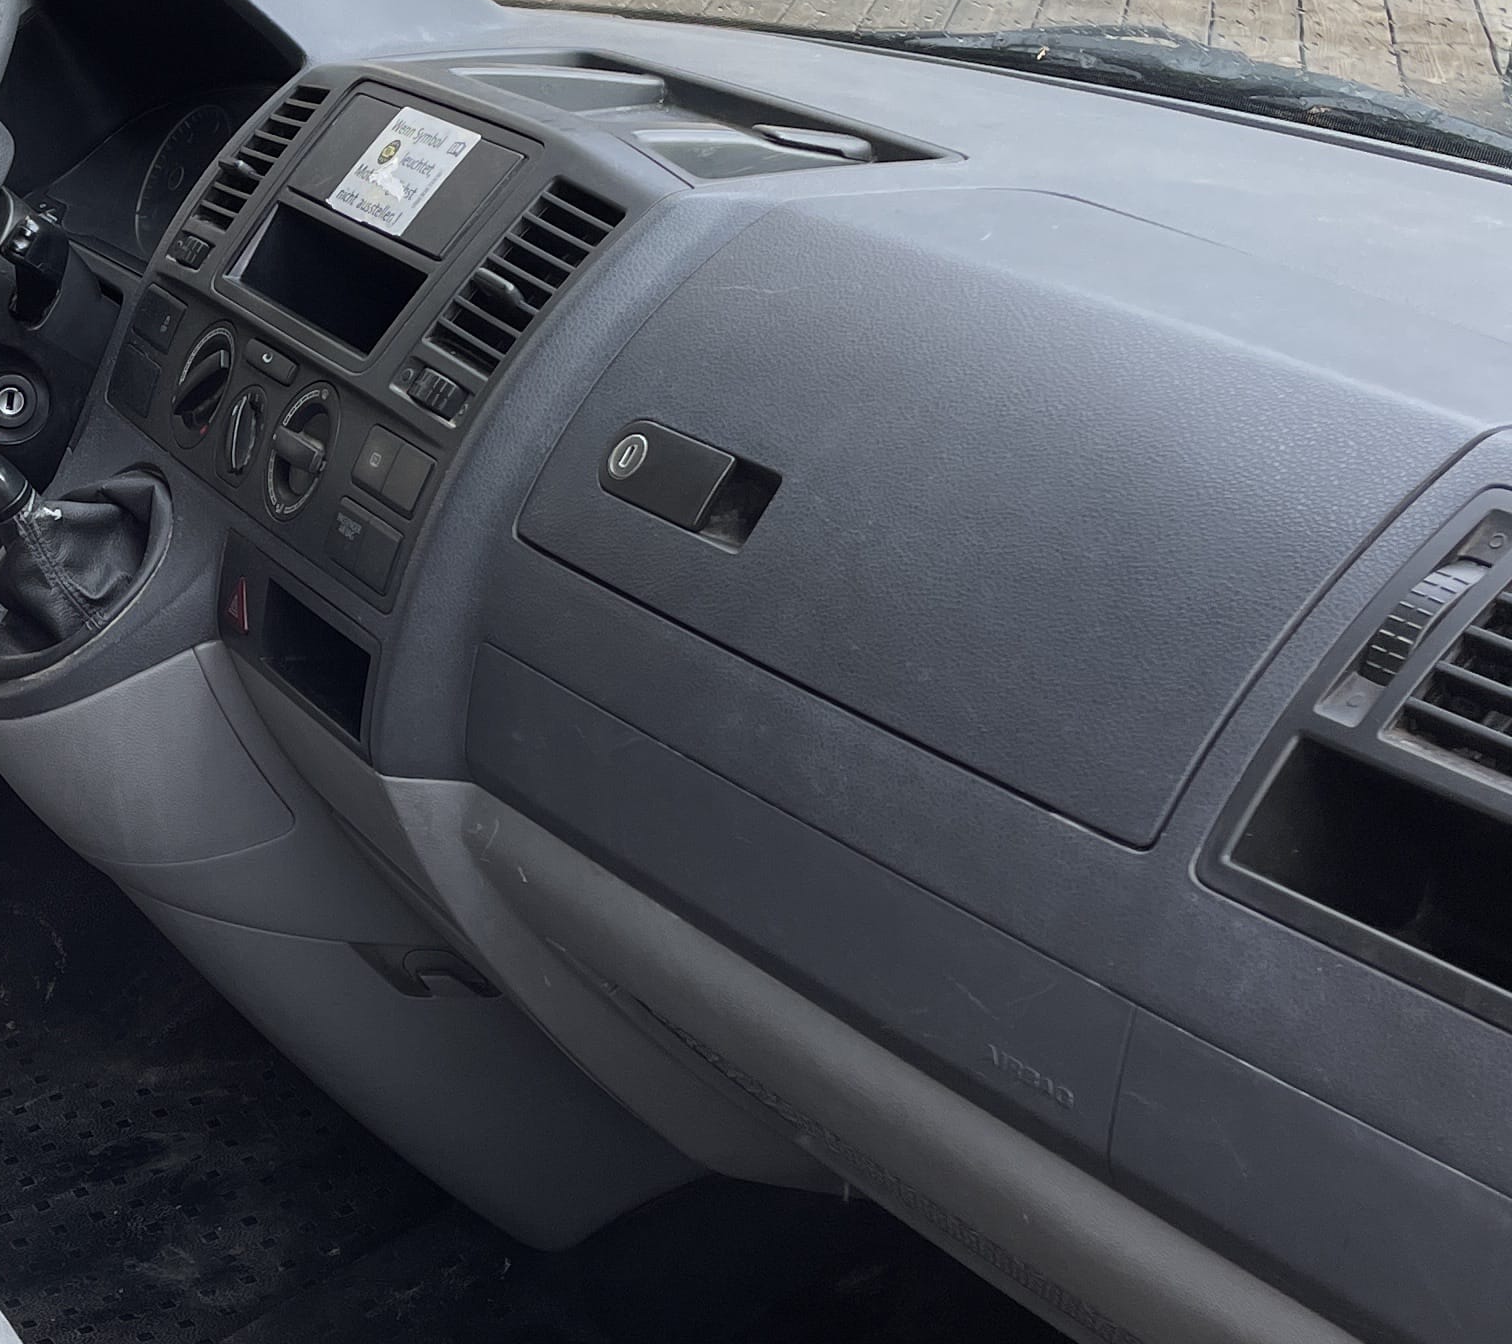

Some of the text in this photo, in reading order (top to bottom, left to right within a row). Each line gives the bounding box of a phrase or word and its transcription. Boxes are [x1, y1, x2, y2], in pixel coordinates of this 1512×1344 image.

[391, 118, 448, 149] Wenn Symbol
[335, 187, 360, 206] nicht
